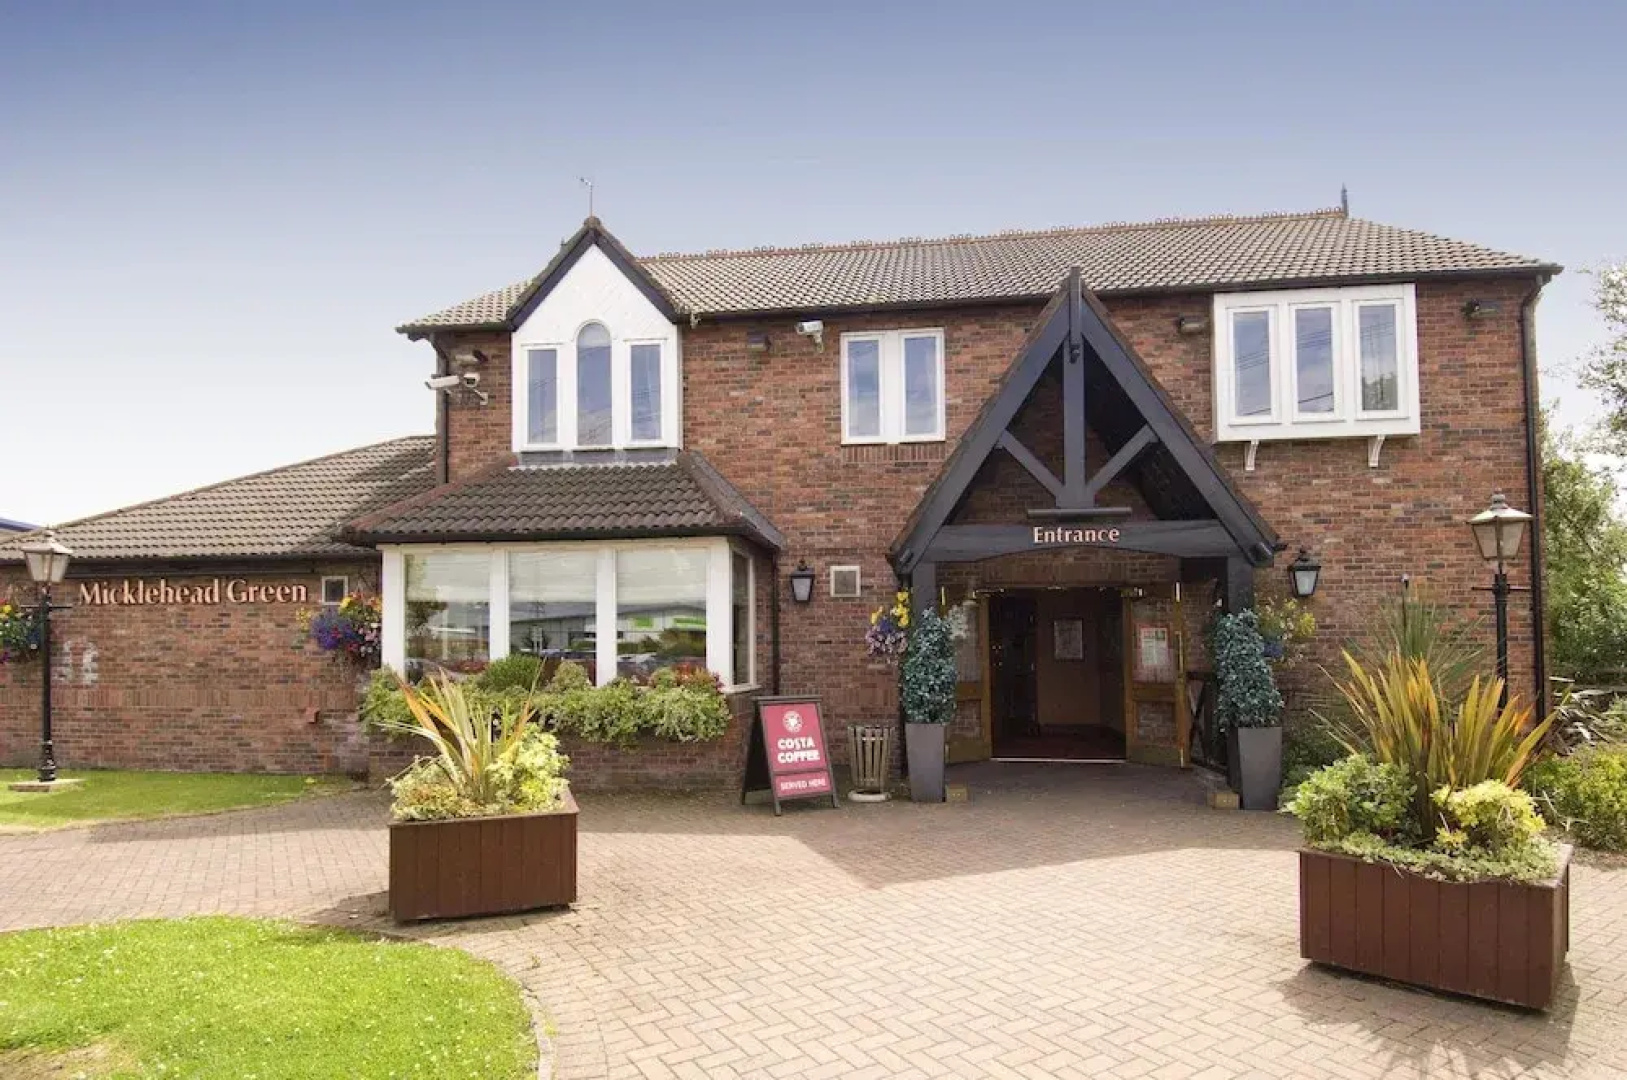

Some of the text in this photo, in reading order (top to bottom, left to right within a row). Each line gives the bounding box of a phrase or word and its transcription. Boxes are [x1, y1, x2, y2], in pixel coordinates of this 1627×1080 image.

[1033, 526, 1120, 543] Entrance
[79, 578, 307, 605] Micklehead Green
[777, 736, 815, 750] COSTA
[777, 749, 820, 763] COFFEE
[780, 779, 807, 790] SERVED
